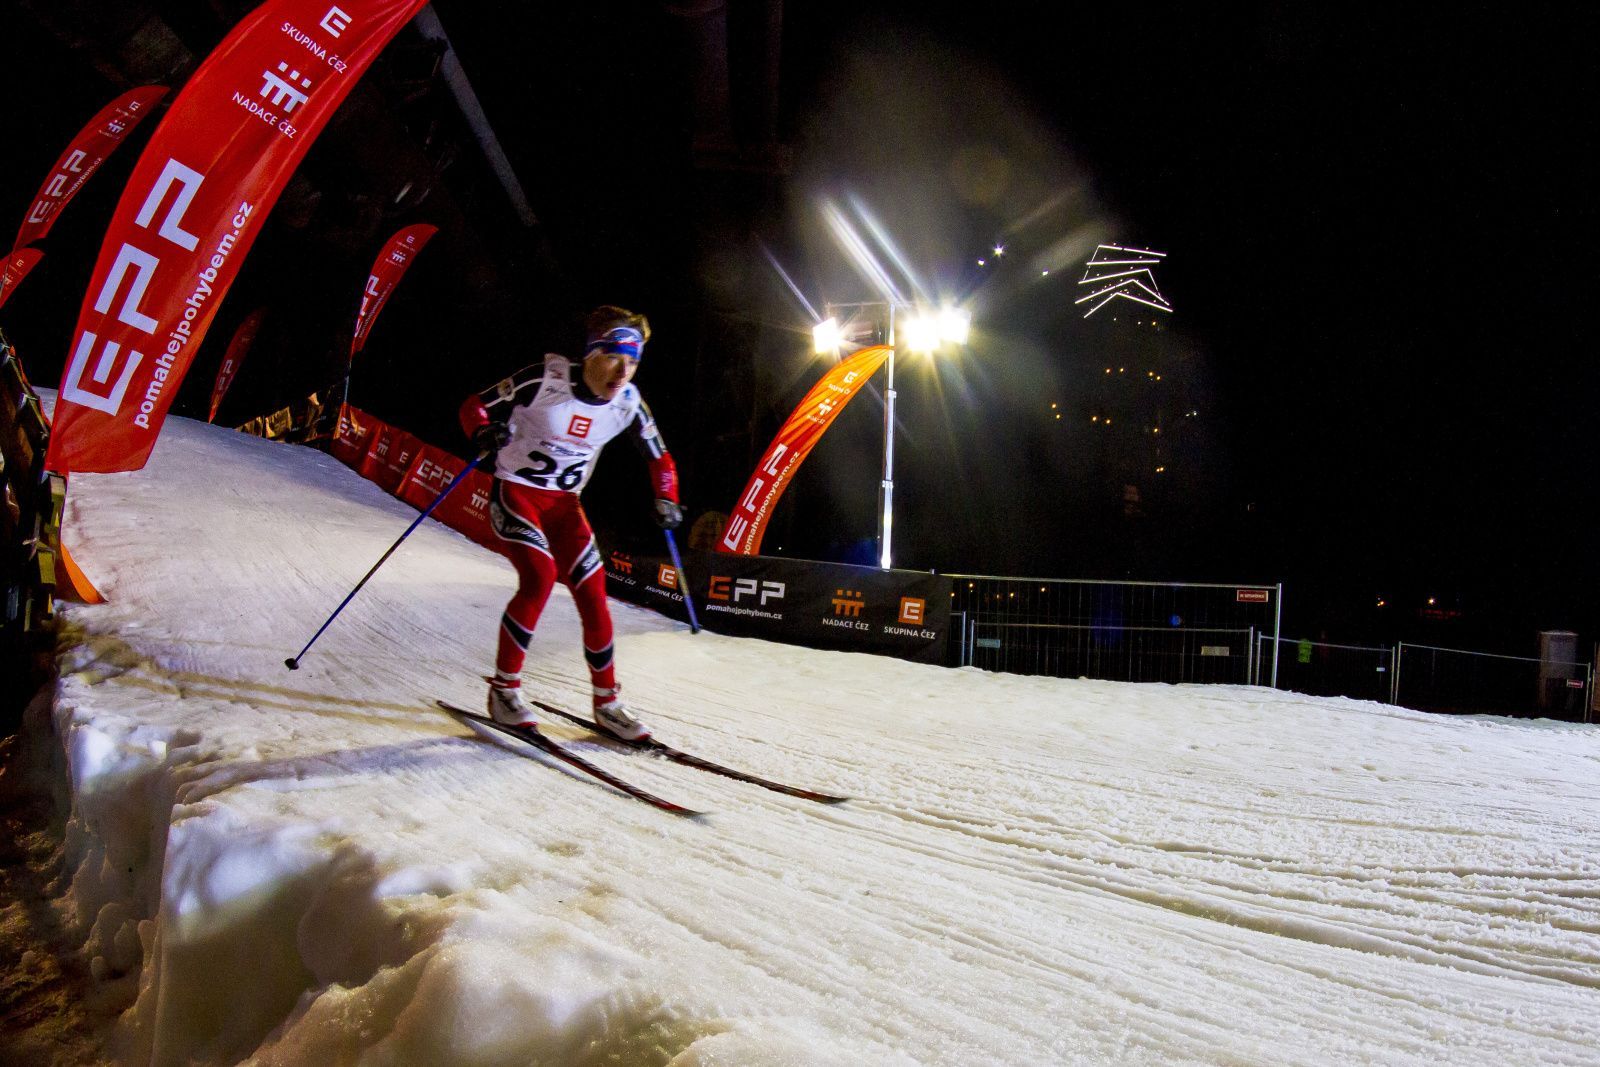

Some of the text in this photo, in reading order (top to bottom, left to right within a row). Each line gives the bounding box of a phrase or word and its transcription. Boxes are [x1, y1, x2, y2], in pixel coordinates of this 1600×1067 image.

[281, 22, 348, 74] SKUPINA ČEZ
[232, 91, 297, 139] NADACE ČEZ
[62, 158, 205, 416] EPP
[134, 201, 253, 430] pomahejpohybem.cz
[416, 459, 455, 488] EPP
[515, 450, 590, 491] 26
[723, 443, 789, 552] EPP
[644, 584, 671, 599] SKUPINA
[708, 575, 786, 606] EPP
[705, 604, 783, 620] pomahejpohybem.cz
[822, 617, 870, 631] NADACE ČEZ
[883, 626, 936, 640] SKUPINA ČEZ
